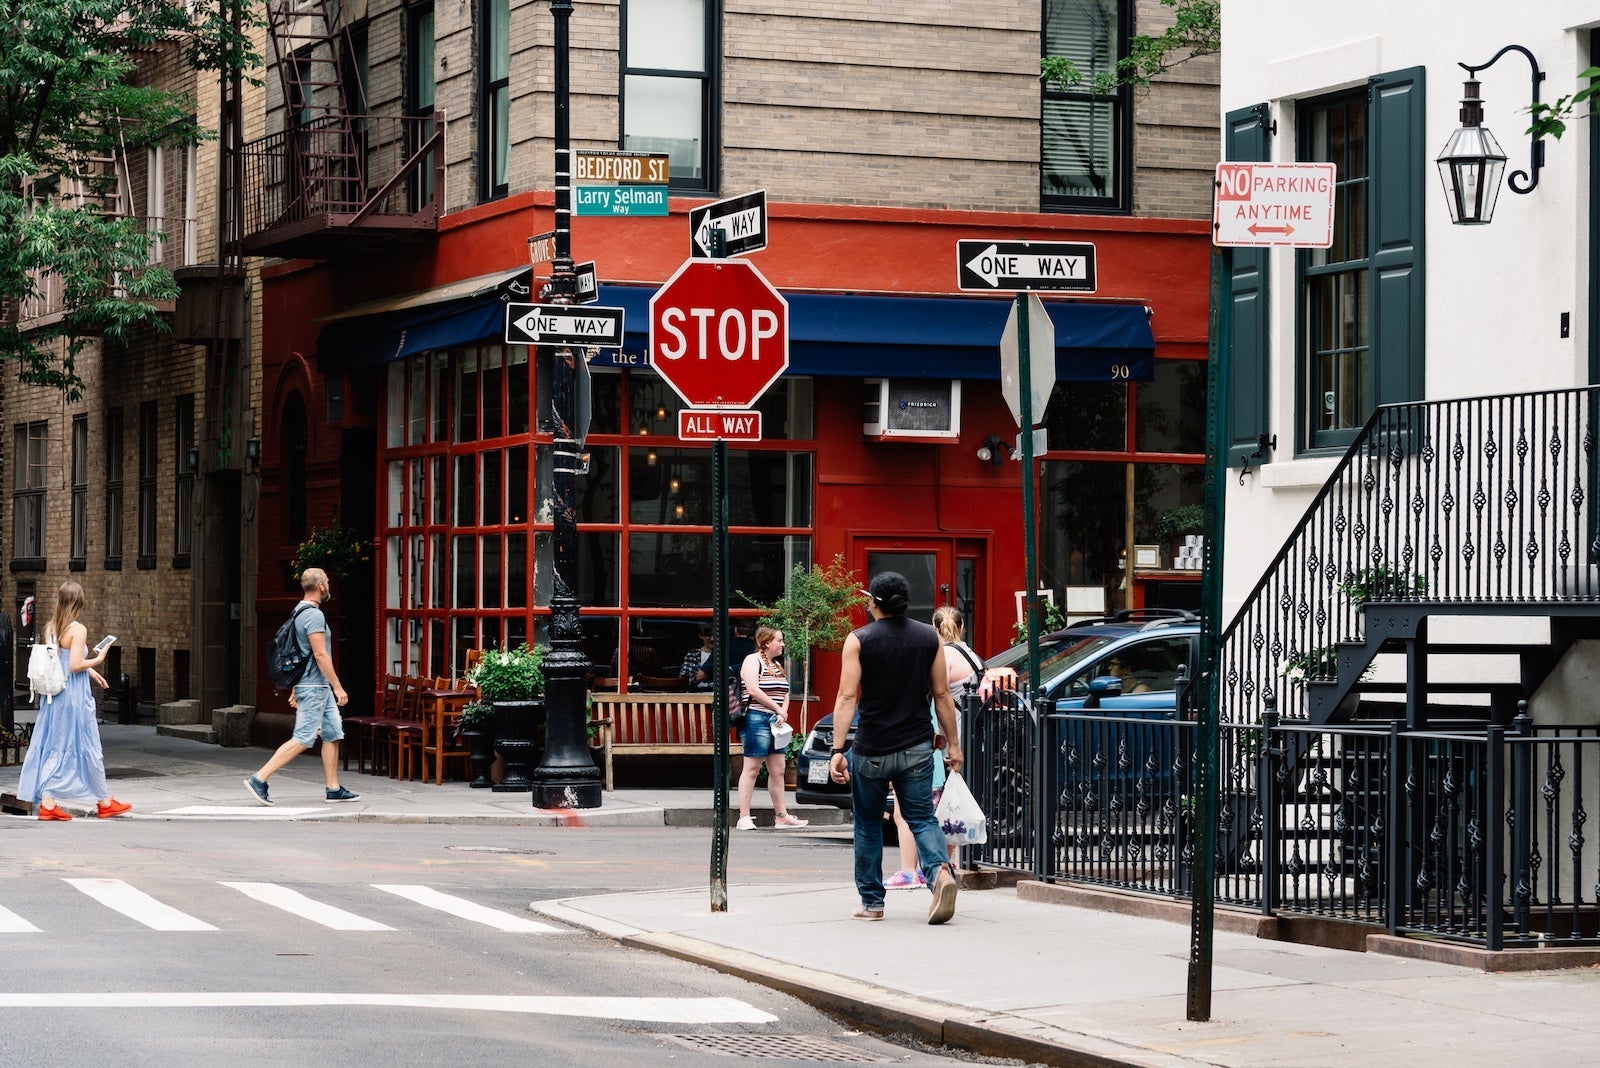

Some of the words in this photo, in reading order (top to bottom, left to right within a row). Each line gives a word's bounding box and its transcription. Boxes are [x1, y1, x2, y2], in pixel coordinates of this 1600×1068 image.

[577, 157, 641, 180] BEDFORD
[648, 159, 665, 181] ST
[1220, 169, 1251, 196] NO
[1253, 177, 1327, 193] PARKING
[578, 189, 610, 208] Larry
[614, 188, 662, 204] Selman
[612, 205, 630, 215] Way
[1235, 204, 1312, 220] ANYTIME
[732, 211, 755, 238] WAY
[530, 239, 550, 264] GROVE
[981, 256, 1019, 275] ONE
[1038, 258, 1077, 277] WAY
[526, 317, 558, 332] ONE
[574, 319, 608, 334] WAY
[660, 307, 779, 361] STOP
[612, 349, 637, 365] the
[1111, 364, 1130, 379] 90
[686, 417, 715, 433] ALL
[722, 417, 754, 434] WAY
